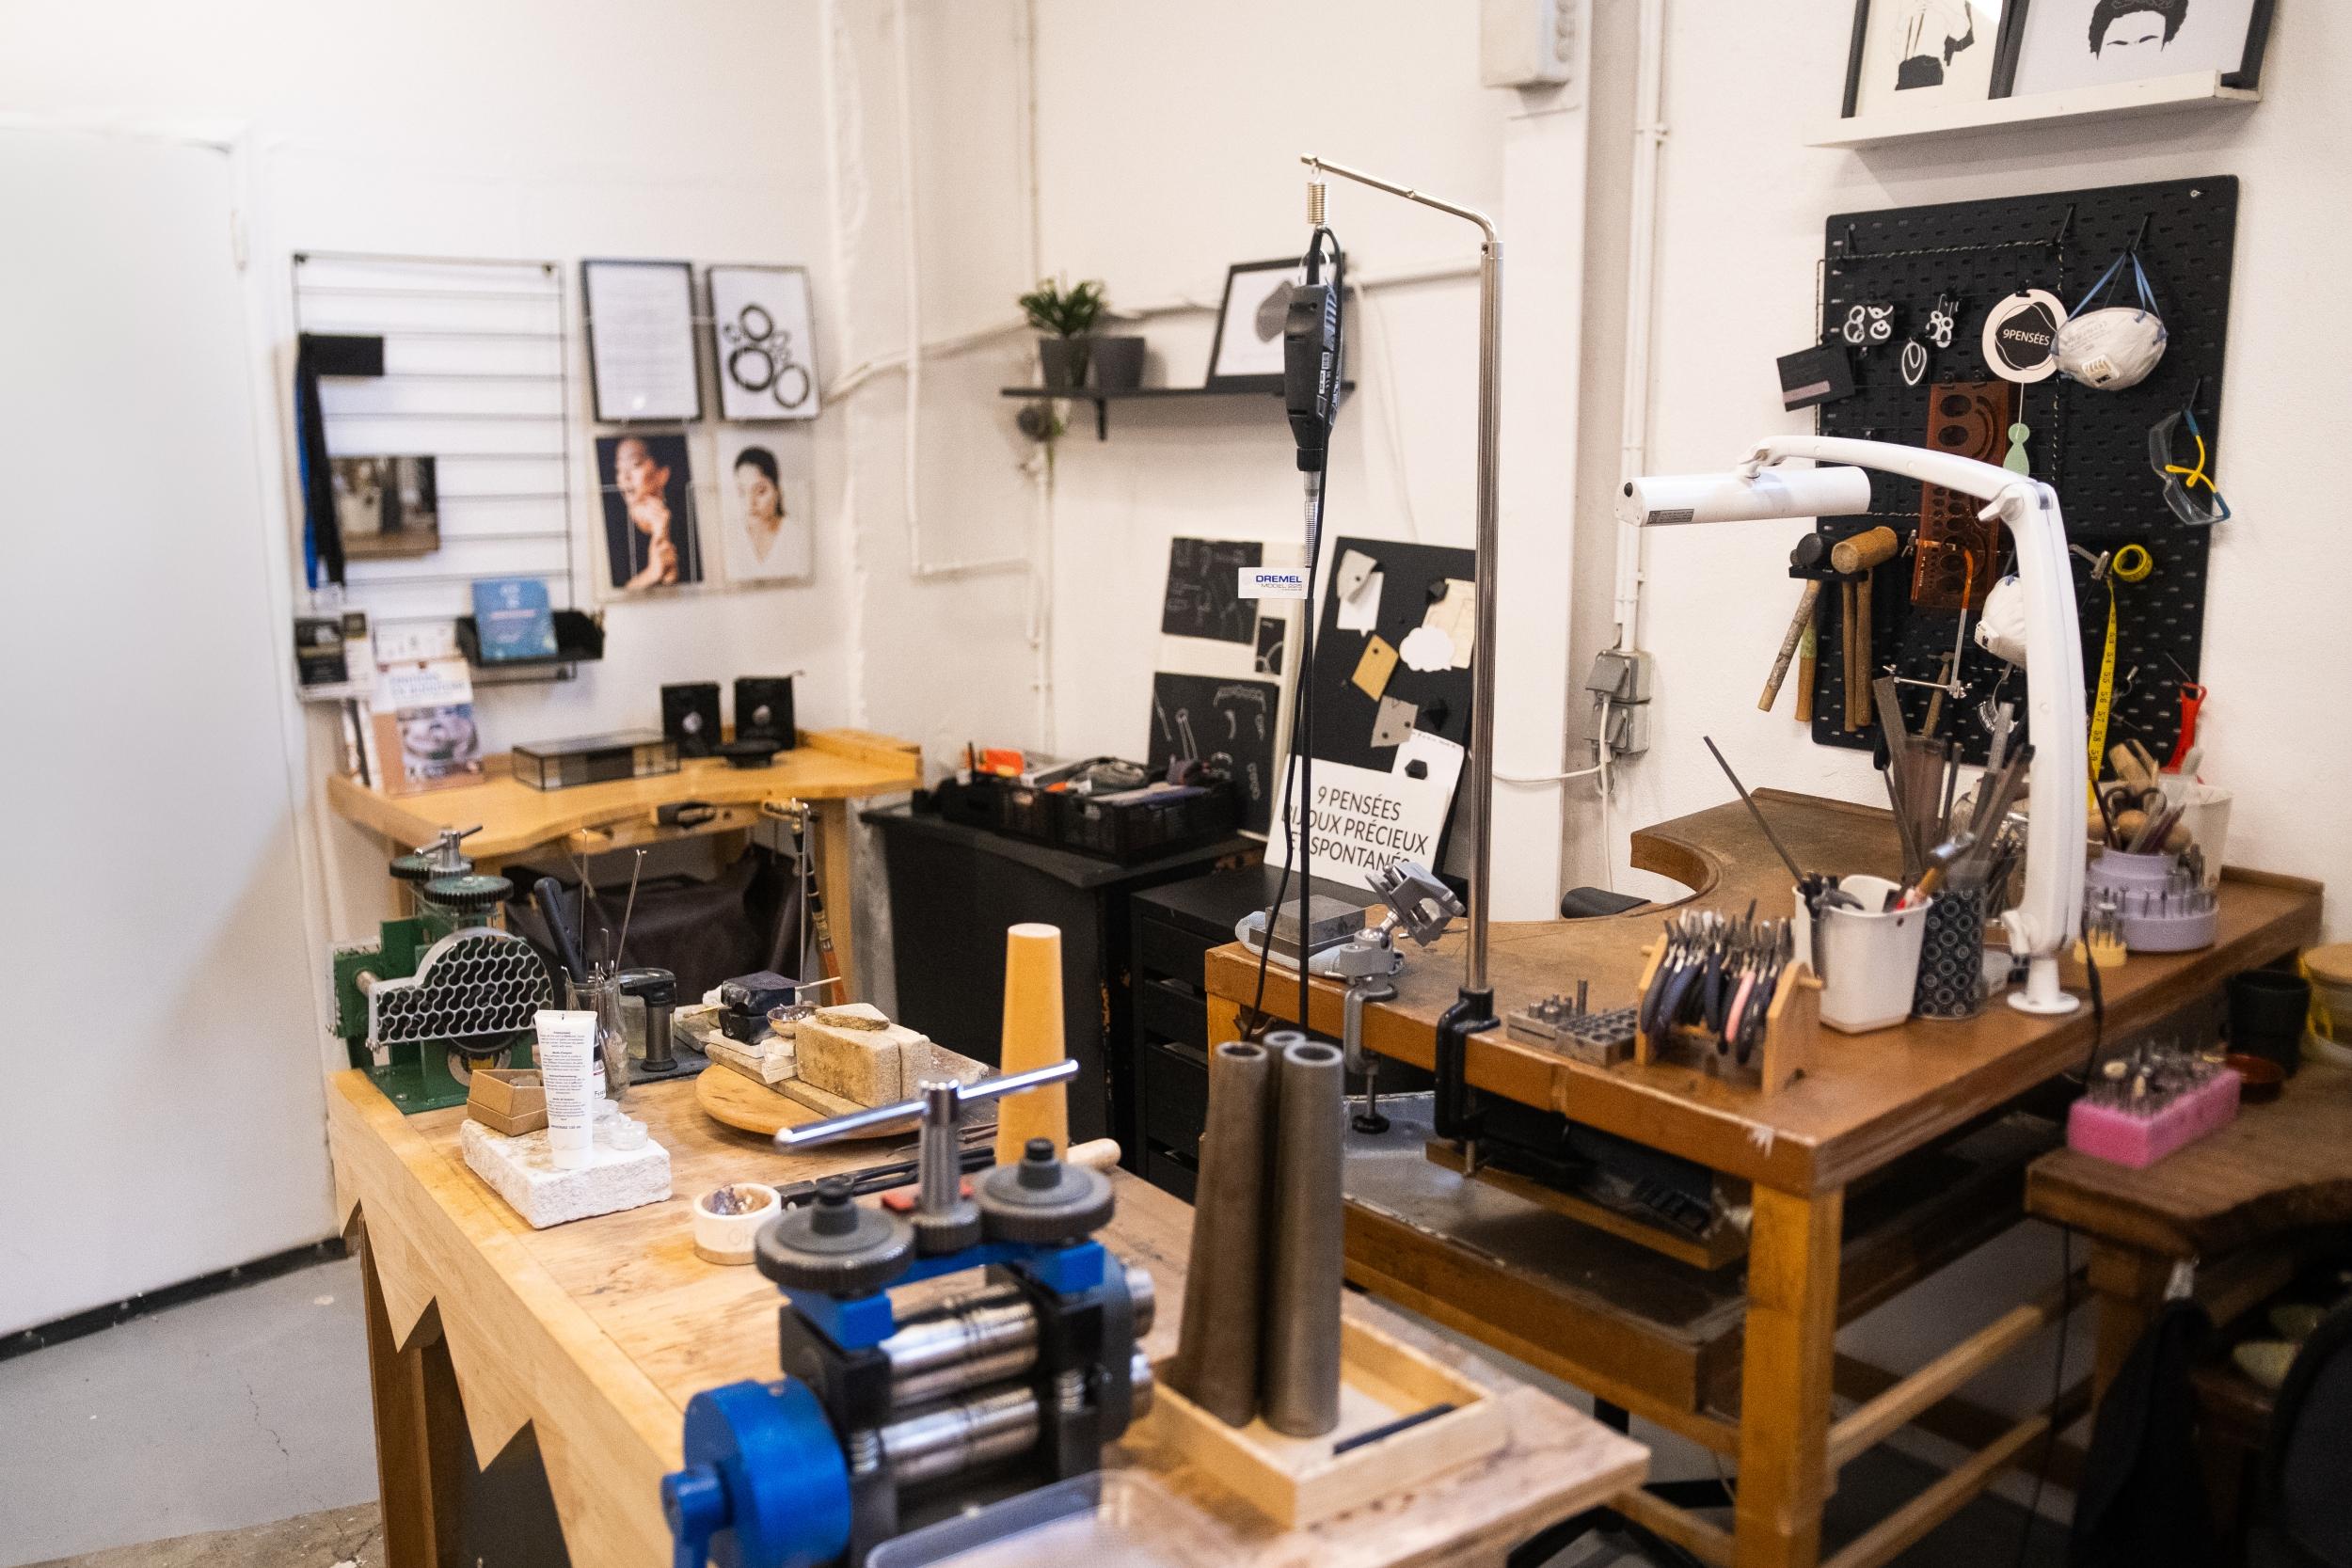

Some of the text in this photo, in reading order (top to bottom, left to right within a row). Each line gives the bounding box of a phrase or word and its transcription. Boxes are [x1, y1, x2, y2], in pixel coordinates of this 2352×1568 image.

[2002, 328, 2051, 347] 9PENSÉES
[1255, 575, 1303, 583] DREMEL
[2106, 651, 2114, 663] 54
[2103, 672, 2111, 684] 55
[2100, 691, 2108, 703] 56
[2096, 710, 2106, 722] 57
[2093, 730, 2102, 742] 58
[1317, 785, 1402, 821] 9 PENSÉES
[1281, 804, 1429, 856] IOUX PRÉCIEUX
[1310, 836, 1410, 872] SPONTAN
